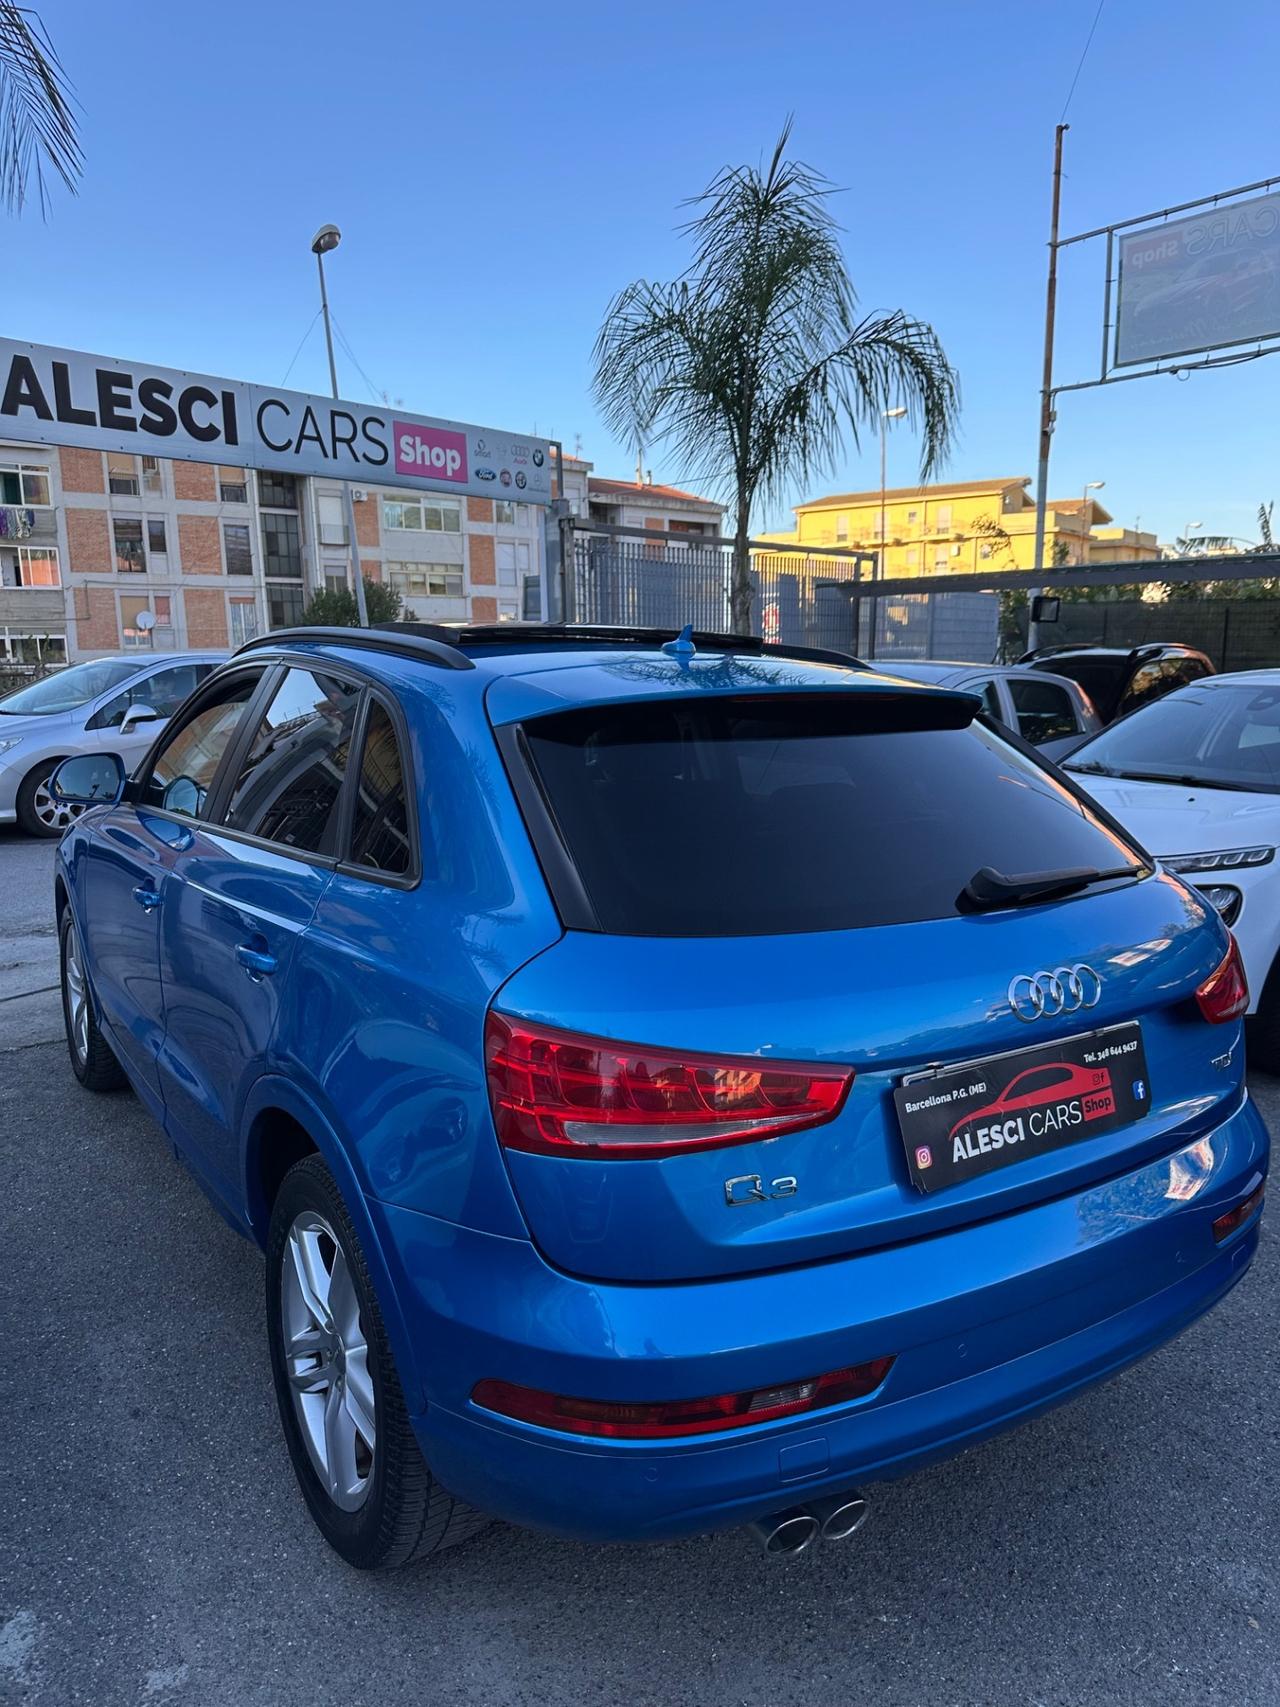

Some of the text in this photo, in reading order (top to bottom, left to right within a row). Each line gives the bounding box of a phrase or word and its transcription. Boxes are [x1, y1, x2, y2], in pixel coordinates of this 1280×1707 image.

[0, 354, 462, 477] ALESCI CARS Shop
[1083, 1051, 1097, 1063] Tel.
[905, 1082, 987, 1113] Barcellona P.G. (ME)
[952, 1096, 1112, 1163] ALESCI CARS Shop
[725, 1174, 797, 1207] Q3
